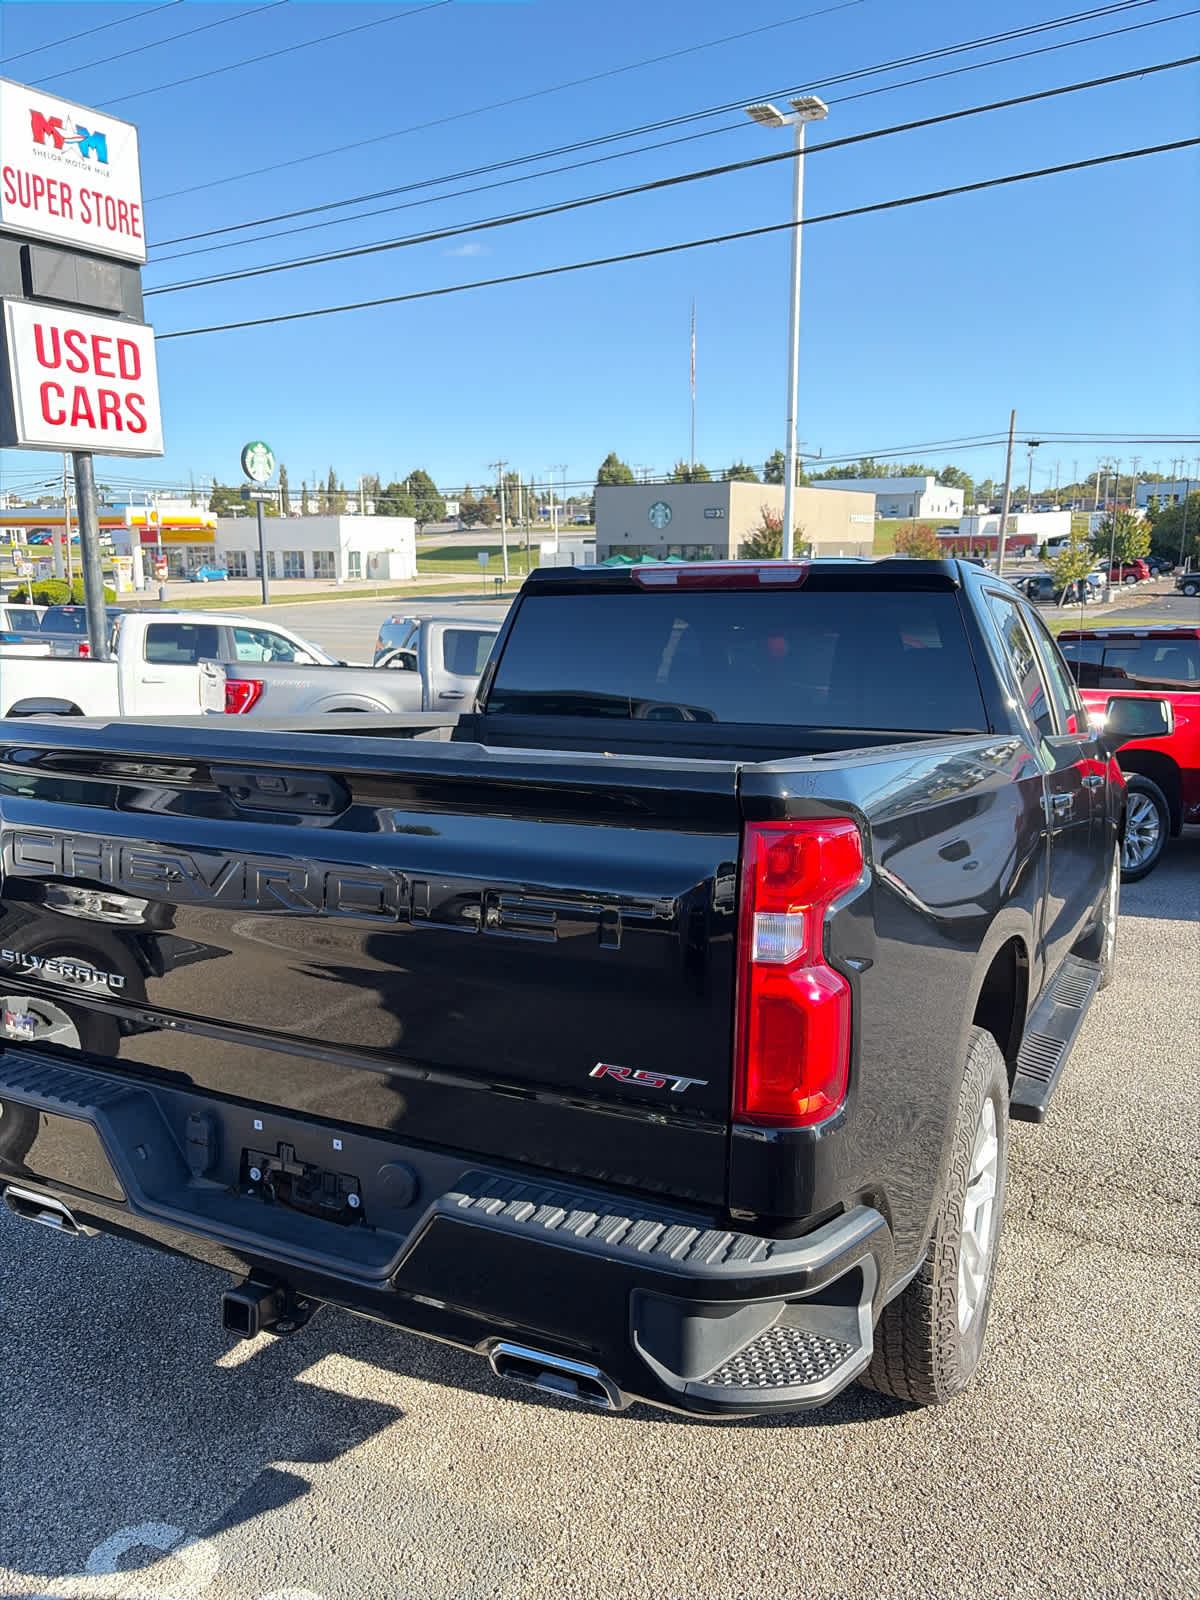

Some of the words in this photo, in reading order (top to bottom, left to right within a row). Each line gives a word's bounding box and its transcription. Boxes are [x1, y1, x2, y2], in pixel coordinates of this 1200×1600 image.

[65, 158, 91, 172] MOTOR
[3, 166, 73, 220] SUPER
[79, 187, 142, 238] STORE
[33, 323, 141, 380] USED
[39, 381, 147, 434] CARS
[12, 831, 657, 950] CHEVROLET
[1, 948, 126, 988] SILVERADO
[589, 1062, 709, 1093] RST
